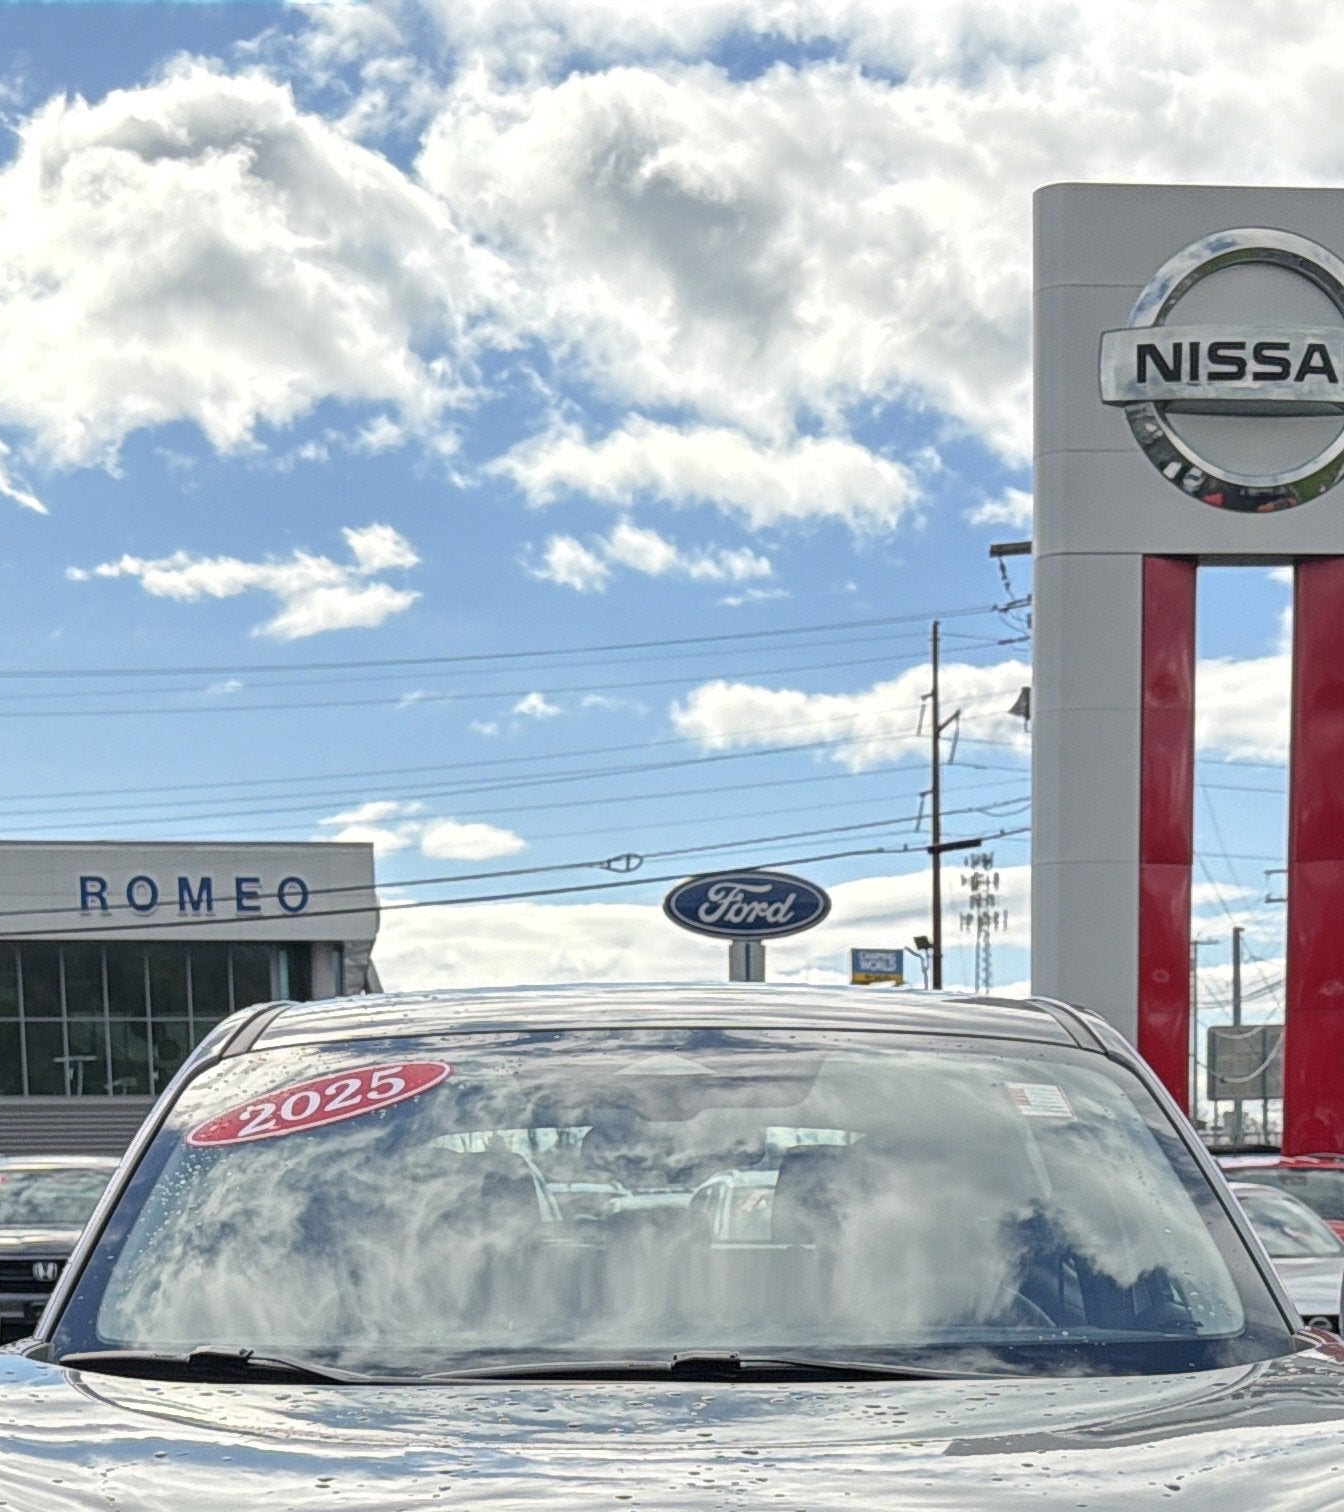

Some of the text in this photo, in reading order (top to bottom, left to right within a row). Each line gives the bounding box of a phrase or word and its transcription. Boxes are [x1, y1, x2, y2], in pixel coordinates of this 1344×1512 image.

[79, 875, 309, 913] ROMEO
[698, 882, 797, 923] Ford
[238, 1067, 405, 1137] 2025
